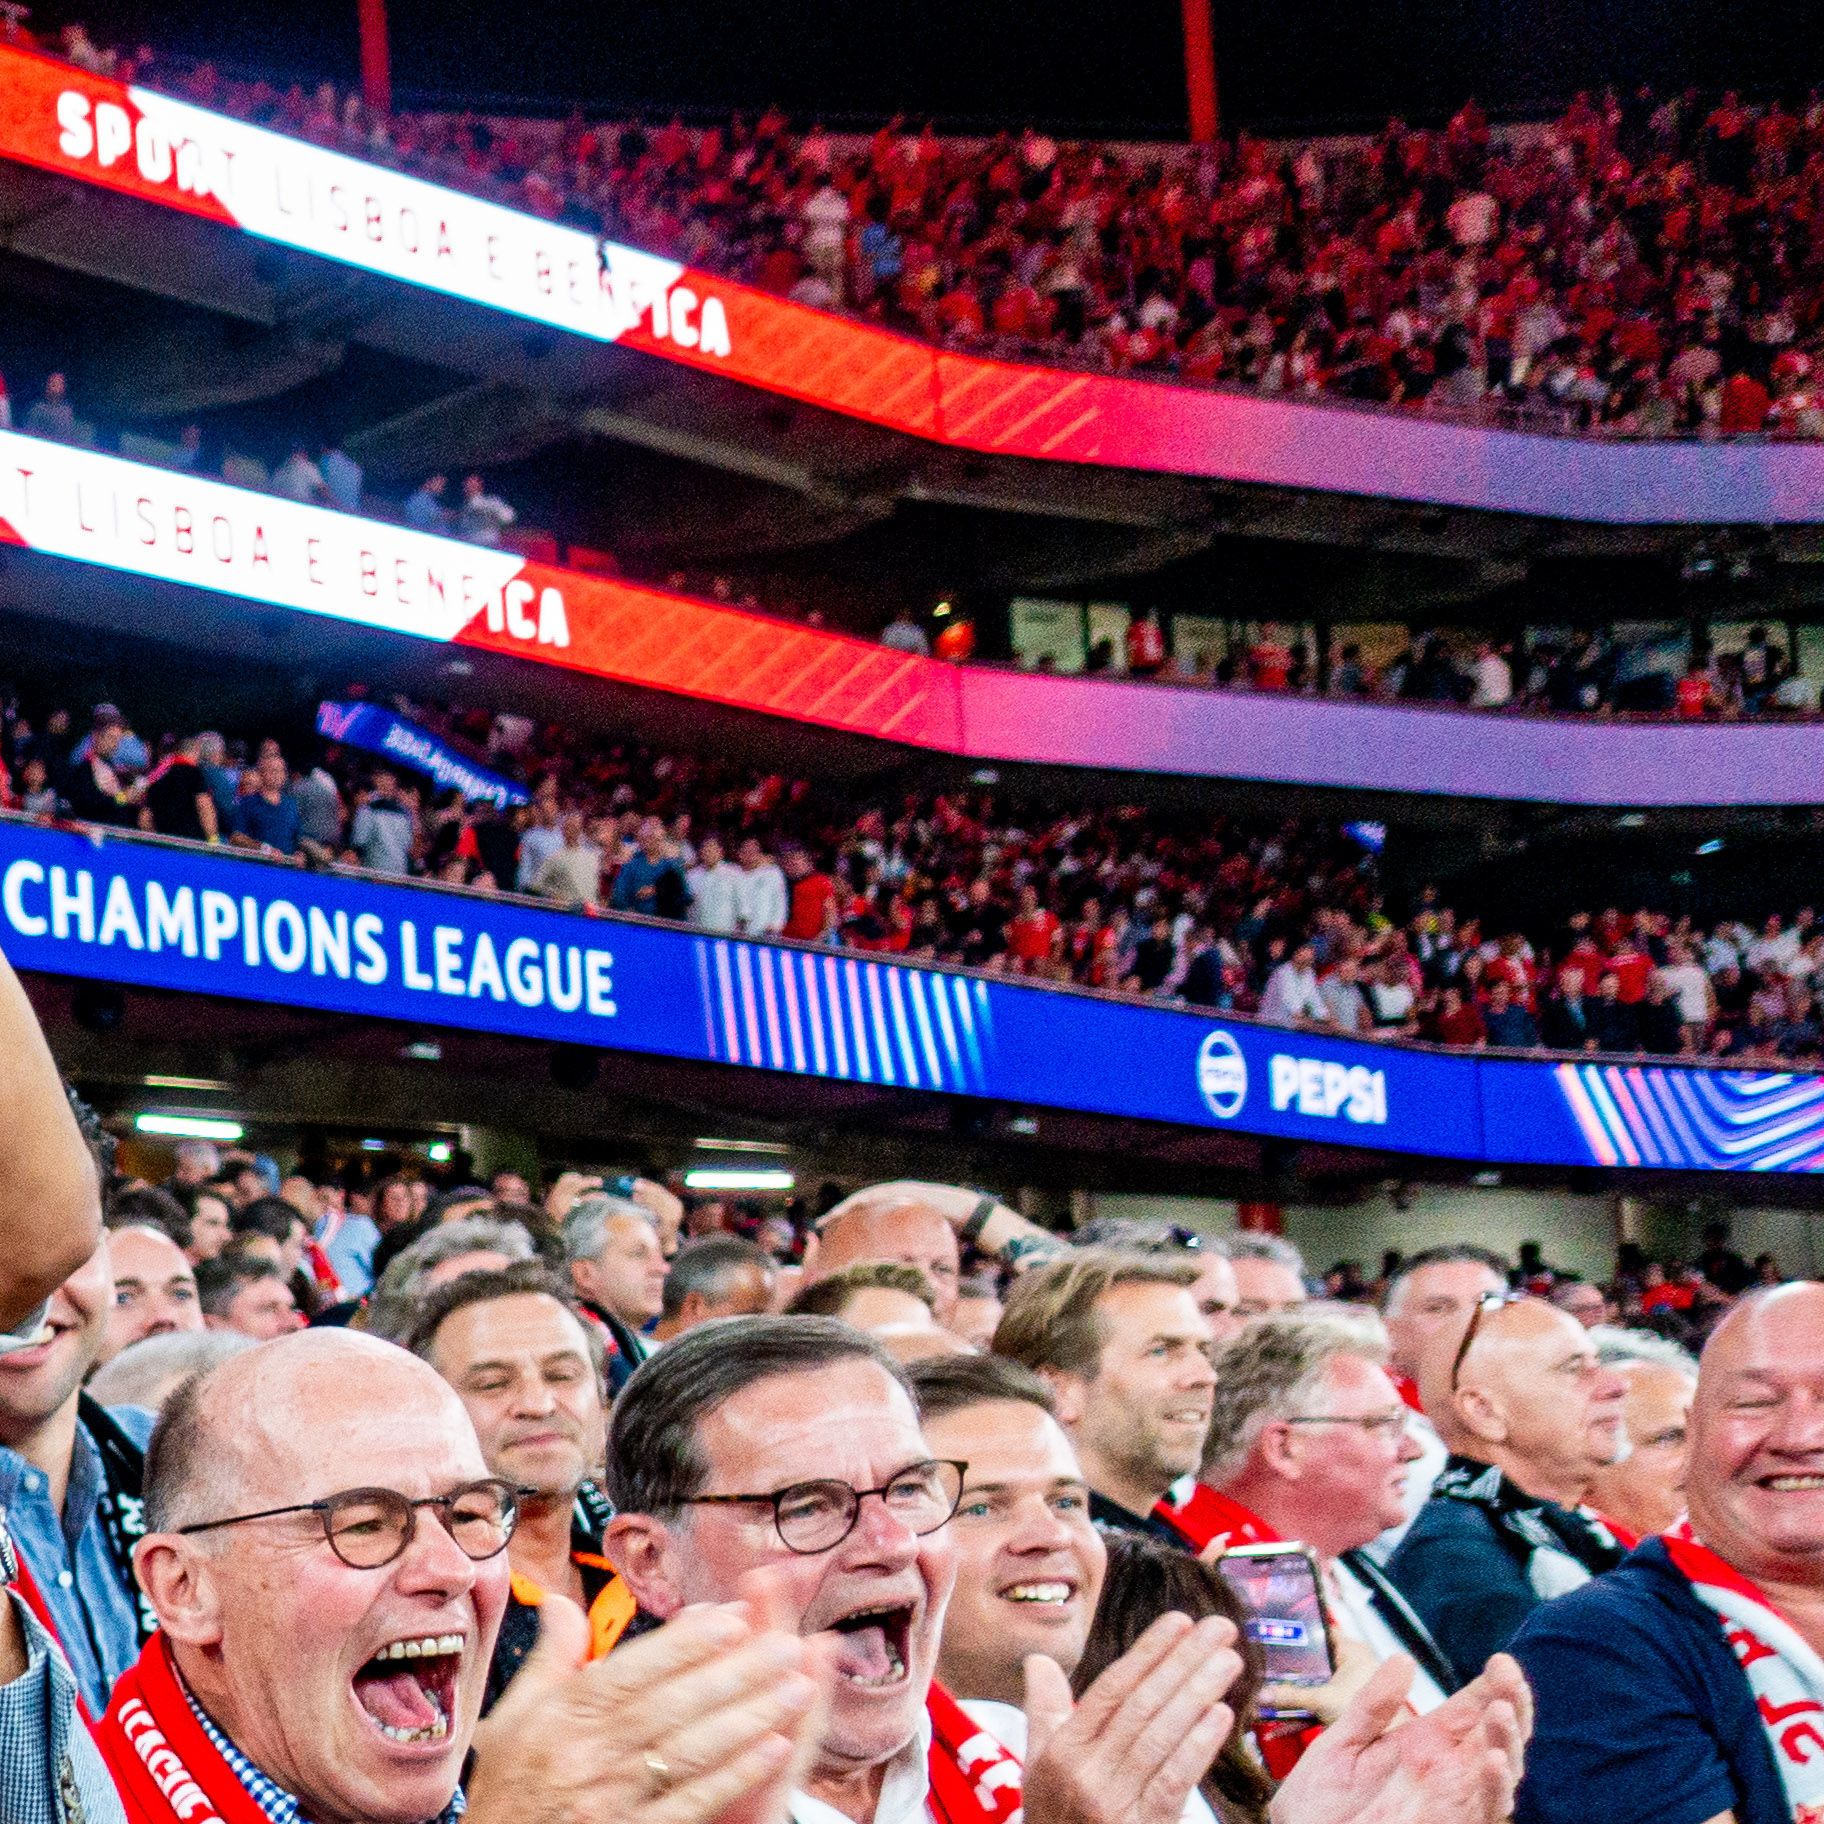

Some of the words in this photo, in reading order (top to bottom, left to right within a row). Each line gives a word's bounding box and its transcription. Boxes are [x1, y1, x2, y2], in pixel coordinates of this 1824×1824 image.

[3, 859, 388, 985] CHAMPIONS
[400, 920, 617, 1016] LEAGUE
[1269, 1053, 1388, 1125] PEPSI
